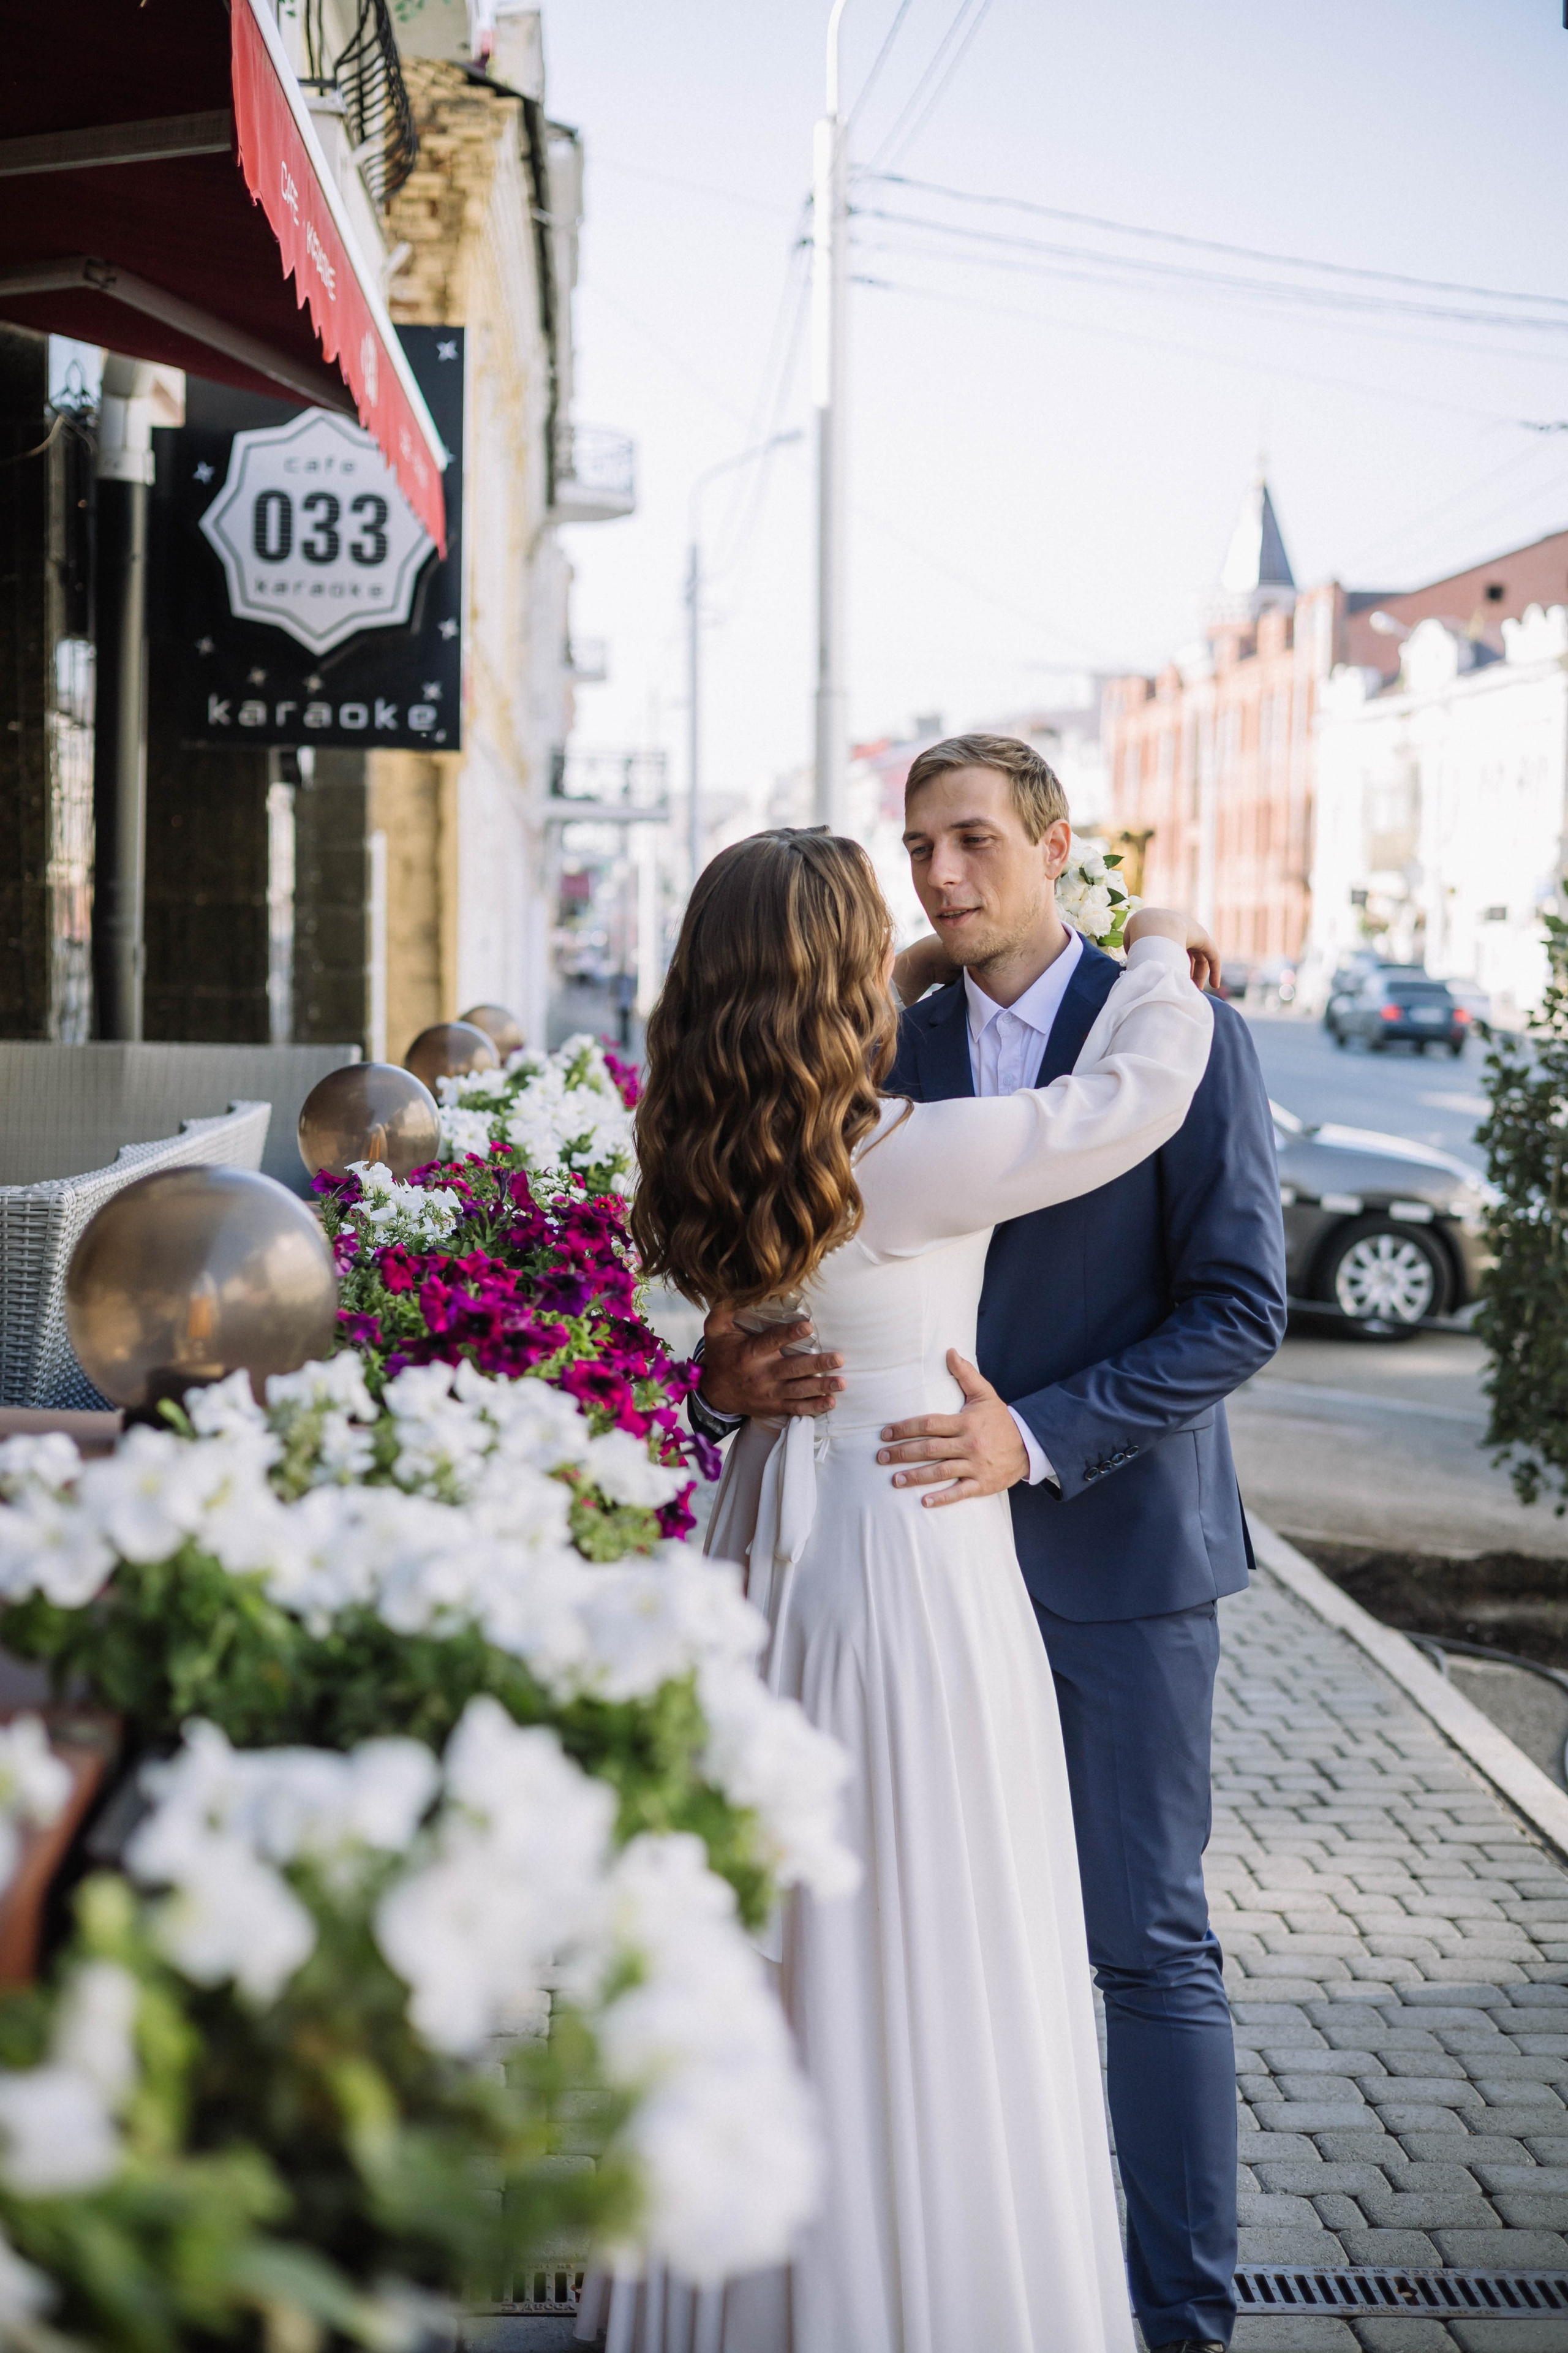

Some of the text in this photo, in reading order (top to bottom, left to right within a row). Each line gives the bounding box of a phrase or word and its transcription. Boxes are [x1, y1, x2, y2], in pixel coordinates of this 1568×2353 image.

[284, 455, 355, 475] cafe
[254, 490, 388, 565] 033
[255, 578, 383, 599] karaoke
[208, 693, 437, 731] karaoke
